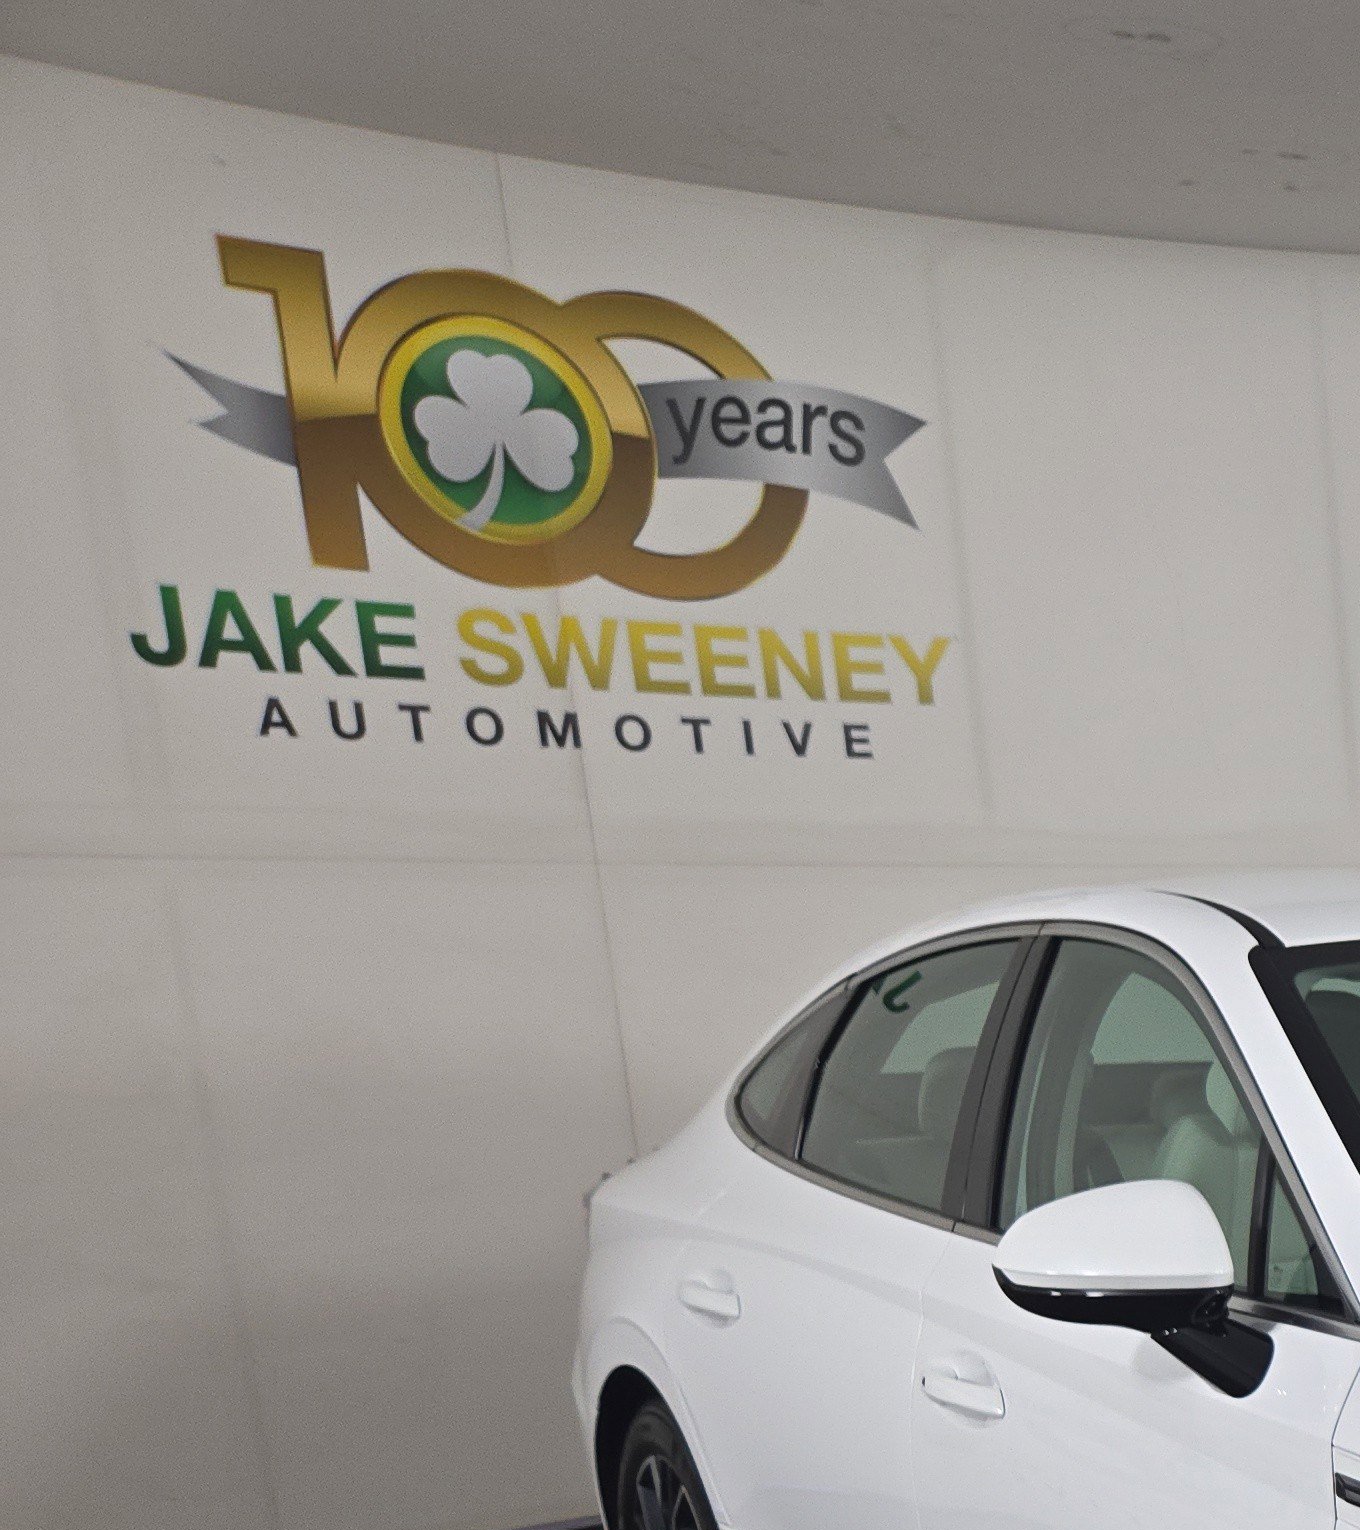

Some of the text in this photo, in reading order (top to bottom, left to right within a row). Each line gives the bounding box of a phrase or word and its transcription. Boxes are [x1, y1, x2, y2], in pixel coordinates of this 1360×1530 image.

[214, 233, 868, 602] 100 years
[129, 582, 951, 706] JAKE SWEENEY
[258, 696, 875, 760] AUTOMOTIVE
